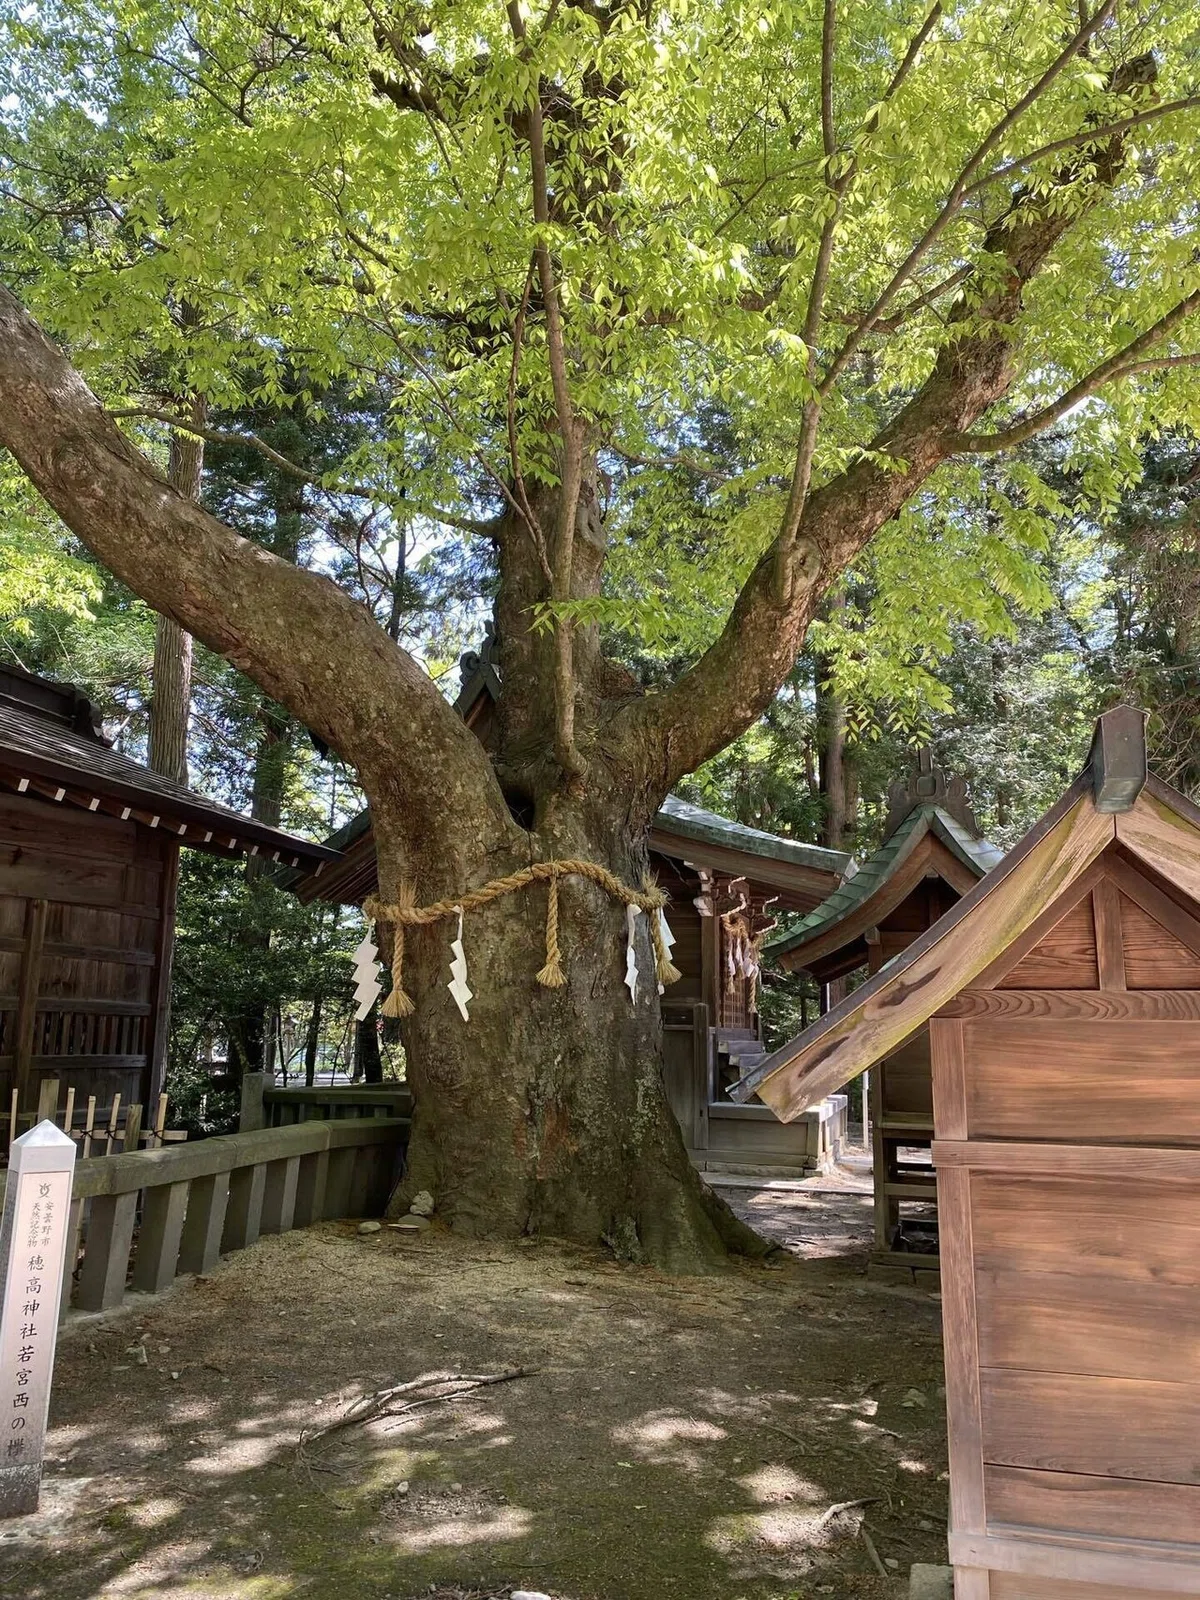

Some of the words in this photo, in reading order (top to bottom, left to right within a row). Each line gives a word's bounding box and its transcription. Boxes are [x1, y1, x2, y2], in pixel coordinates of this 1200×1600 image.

[27, 1202, 41, 1248] 天然記念物
[41, 1201, 54, 1247] 安曇野市
